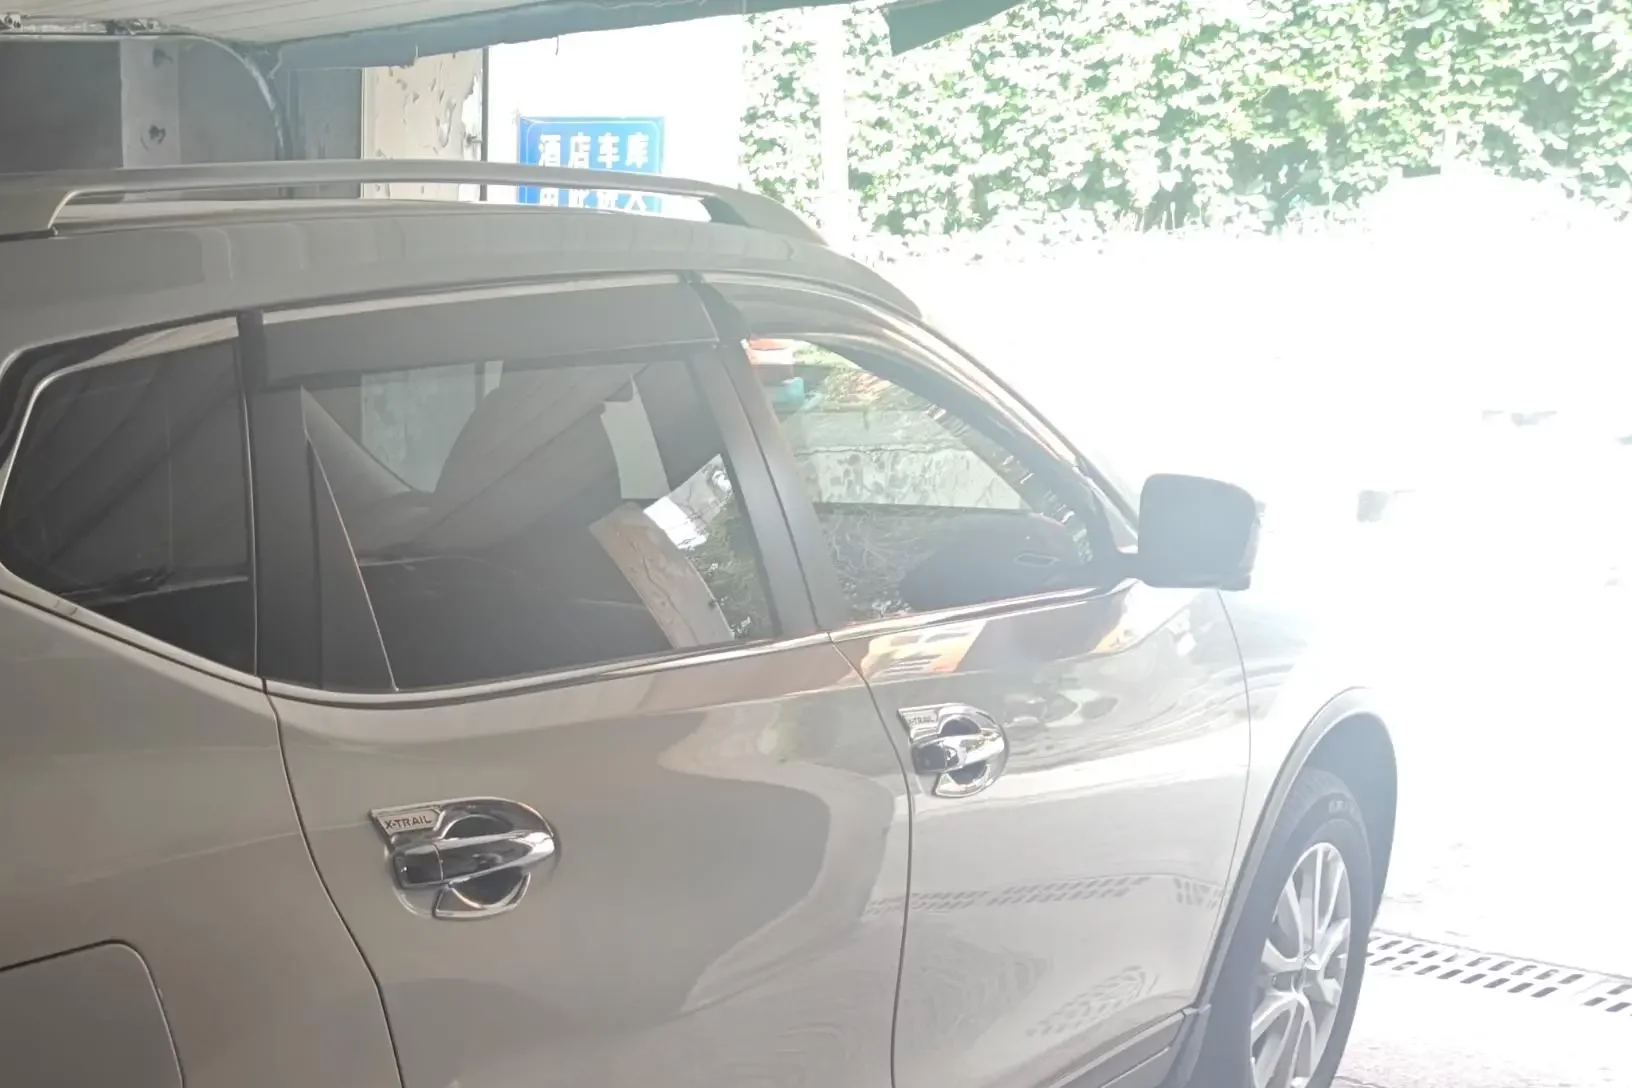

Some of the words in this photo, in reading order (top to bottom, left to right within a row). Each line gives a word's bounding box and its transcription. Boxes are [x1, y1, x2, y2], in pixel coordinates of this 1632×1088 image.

[538, 132, 649, 169] 酒店车库
[384, 815, 433, 829] X-TRAIL
